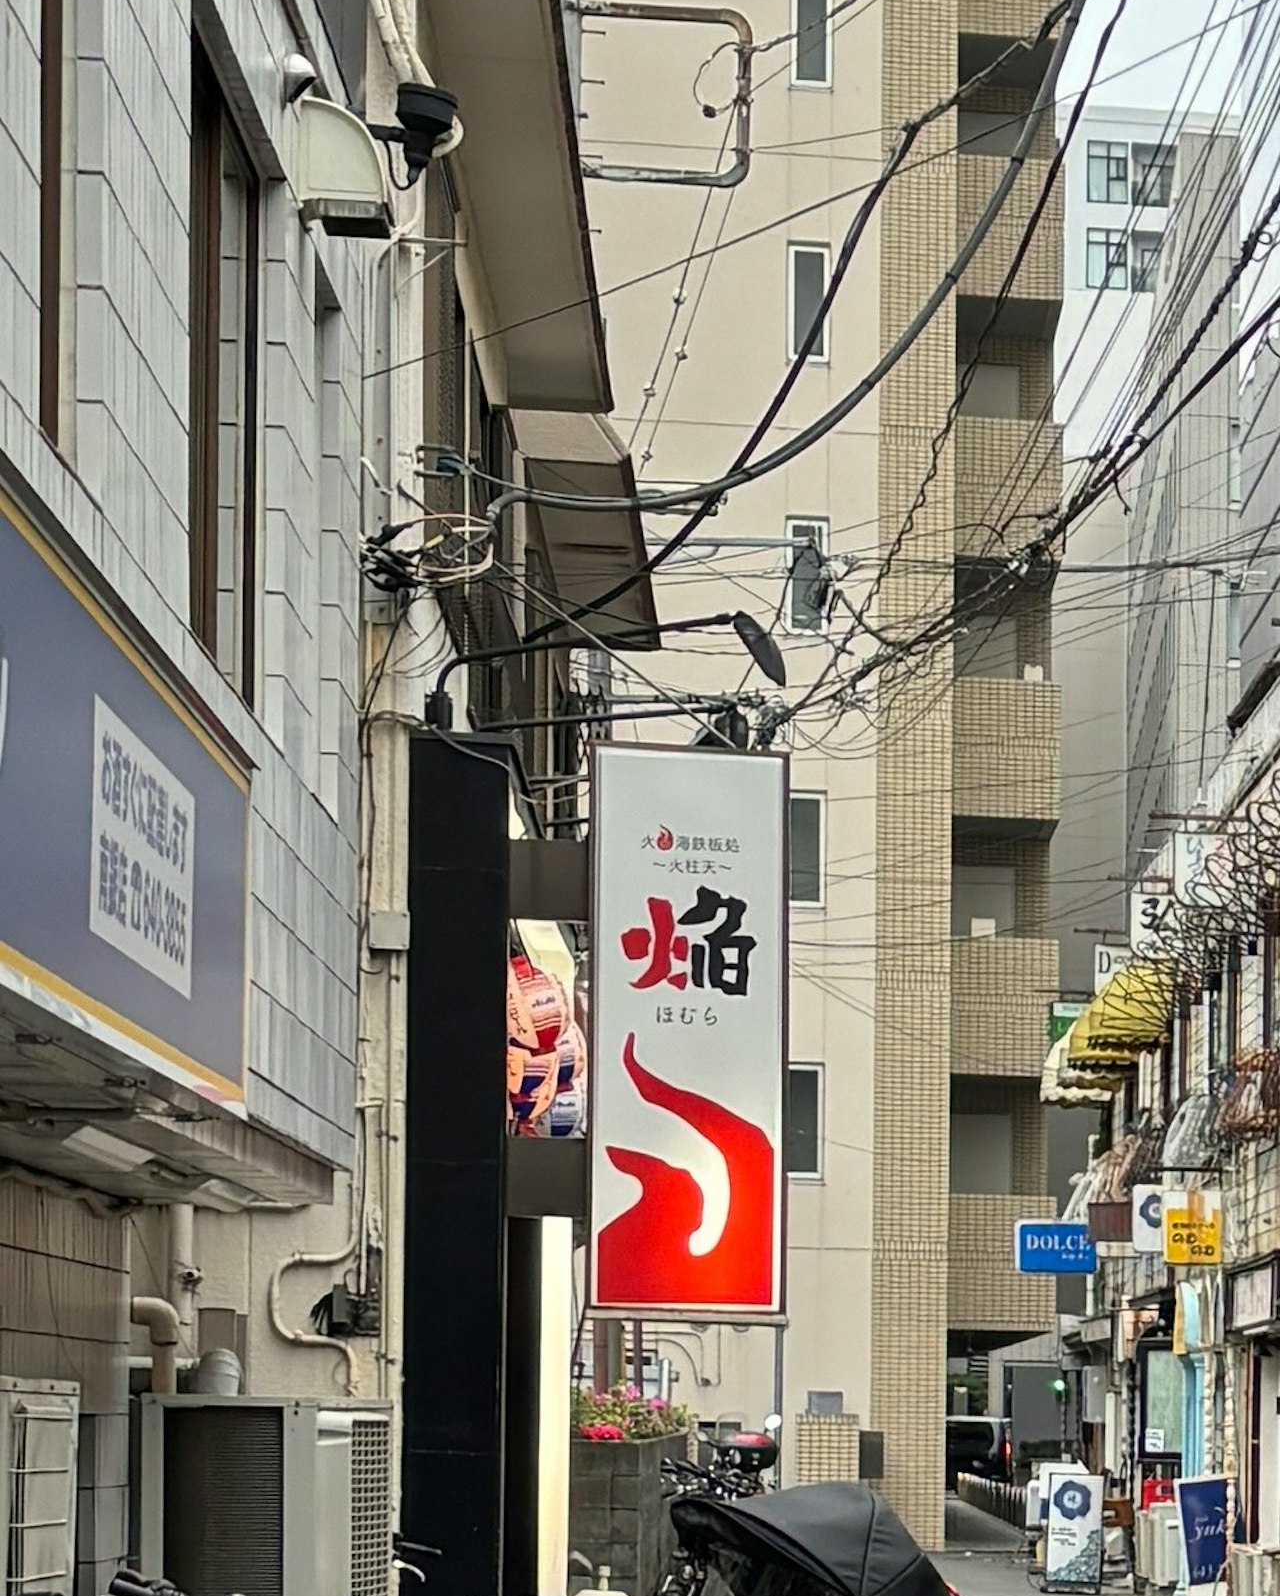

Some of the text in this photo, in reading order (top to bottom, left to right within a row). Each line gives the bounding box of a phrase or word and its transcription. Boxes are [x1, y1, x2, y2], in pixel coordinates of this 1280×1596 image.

[620, 885, 758, 997] 焔
[656, 1006, 718, 1026] ほむら
